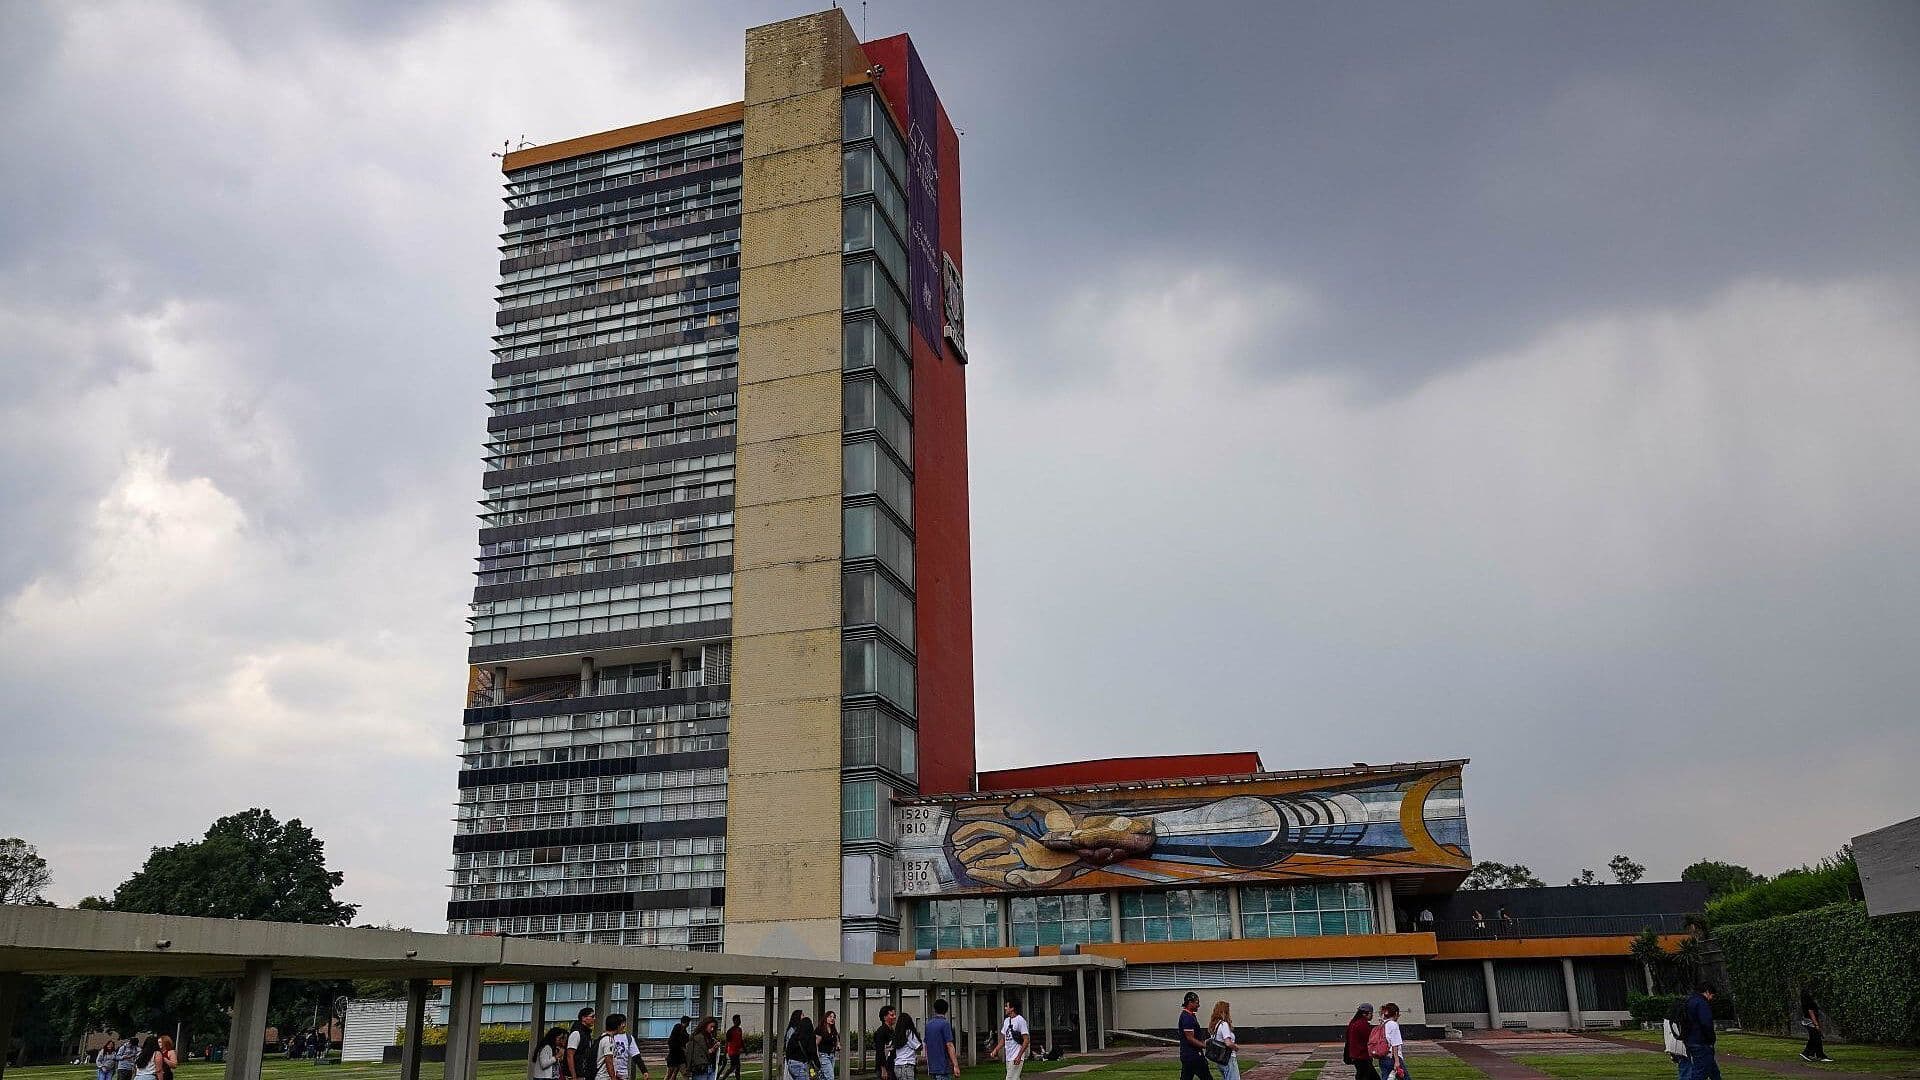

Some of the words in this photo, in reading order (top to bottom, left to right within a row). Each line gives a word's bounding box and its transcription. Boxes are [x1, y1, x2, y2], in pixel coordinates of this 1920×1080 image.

[901, 809, 929, 819] 1520
[901, 823, 926, 834] 1810
[902, 861, 930, 870] 1857
[903, 871, 927, 880] 1910
